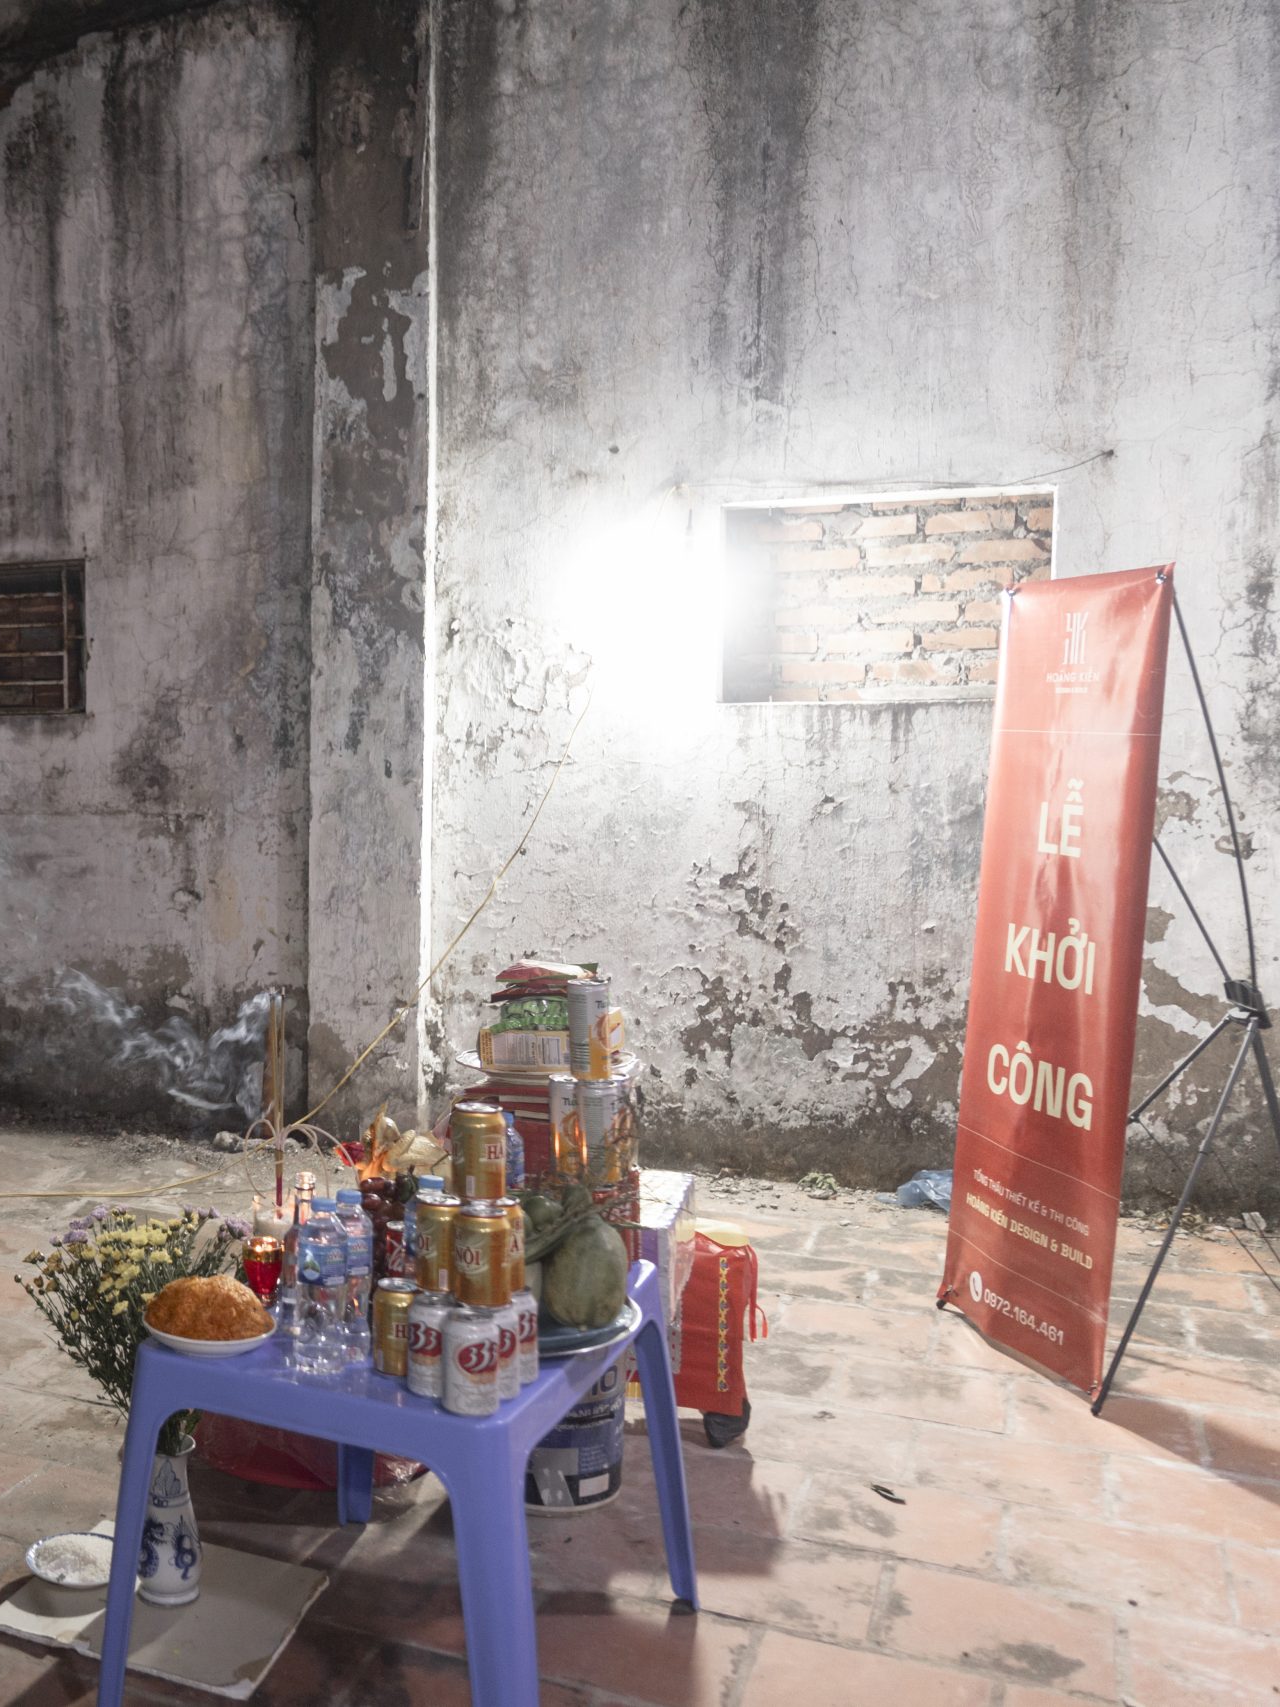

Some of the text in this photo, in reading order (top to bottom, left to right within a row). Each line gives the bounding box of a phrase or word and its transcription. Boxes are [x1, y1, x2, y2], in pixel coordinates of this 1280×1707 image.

[1038, 778, 1084, 858] LỄ
[1005, 918, 1096, 995] KHỞI
[987, 1040, 1093, 1131] CÔNG
[966, 1192, 990, 1217] HOÀNG
[1010, 1219, 1048, 1248] DESIGN
[1050, 1239, 1058, 1252] &
[1060, 1243, 1093, 1270] BUILD
[1005, 1188, 1027, 1207] THIẾT
[1028, 1200, 1041, 1213] KẾ
[1041, 1205, 1048, 1217] &
[1049, 1208, 1064, 1224] THI
[1065, 1217, 1089, 1236] CÔNG
[984, 1288, 1064, 1346] 0972.164.461
